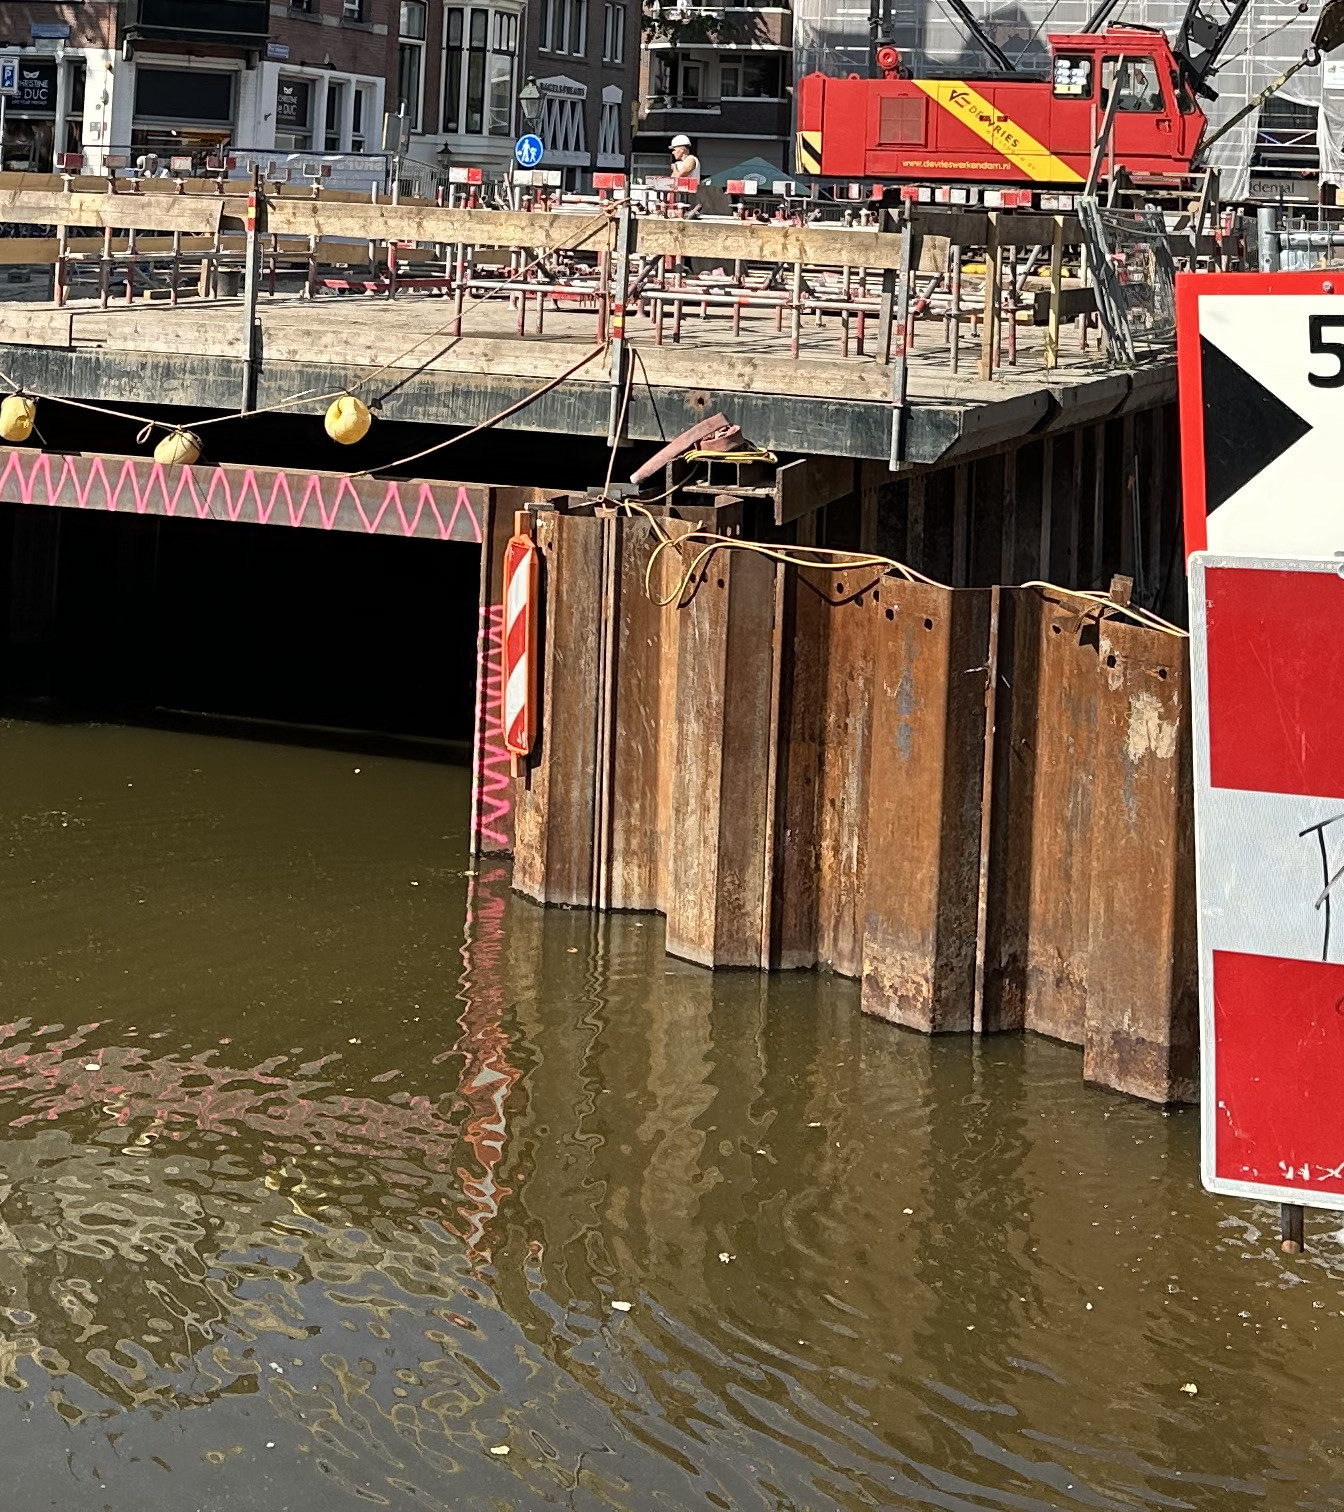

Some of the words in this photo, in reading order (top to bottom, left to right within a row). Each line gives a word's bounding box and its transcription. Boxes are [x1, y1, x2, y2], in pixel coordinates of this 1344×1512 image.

[17, 79, 49, 88] HRISTINE
[24, 88, 49, 100] DUC
[283, 103, 297, 115] DUC
[987, 119, 1020, 148] VRIES
[902, 159, 1011, 170] www.devrieswerkendam.nl
